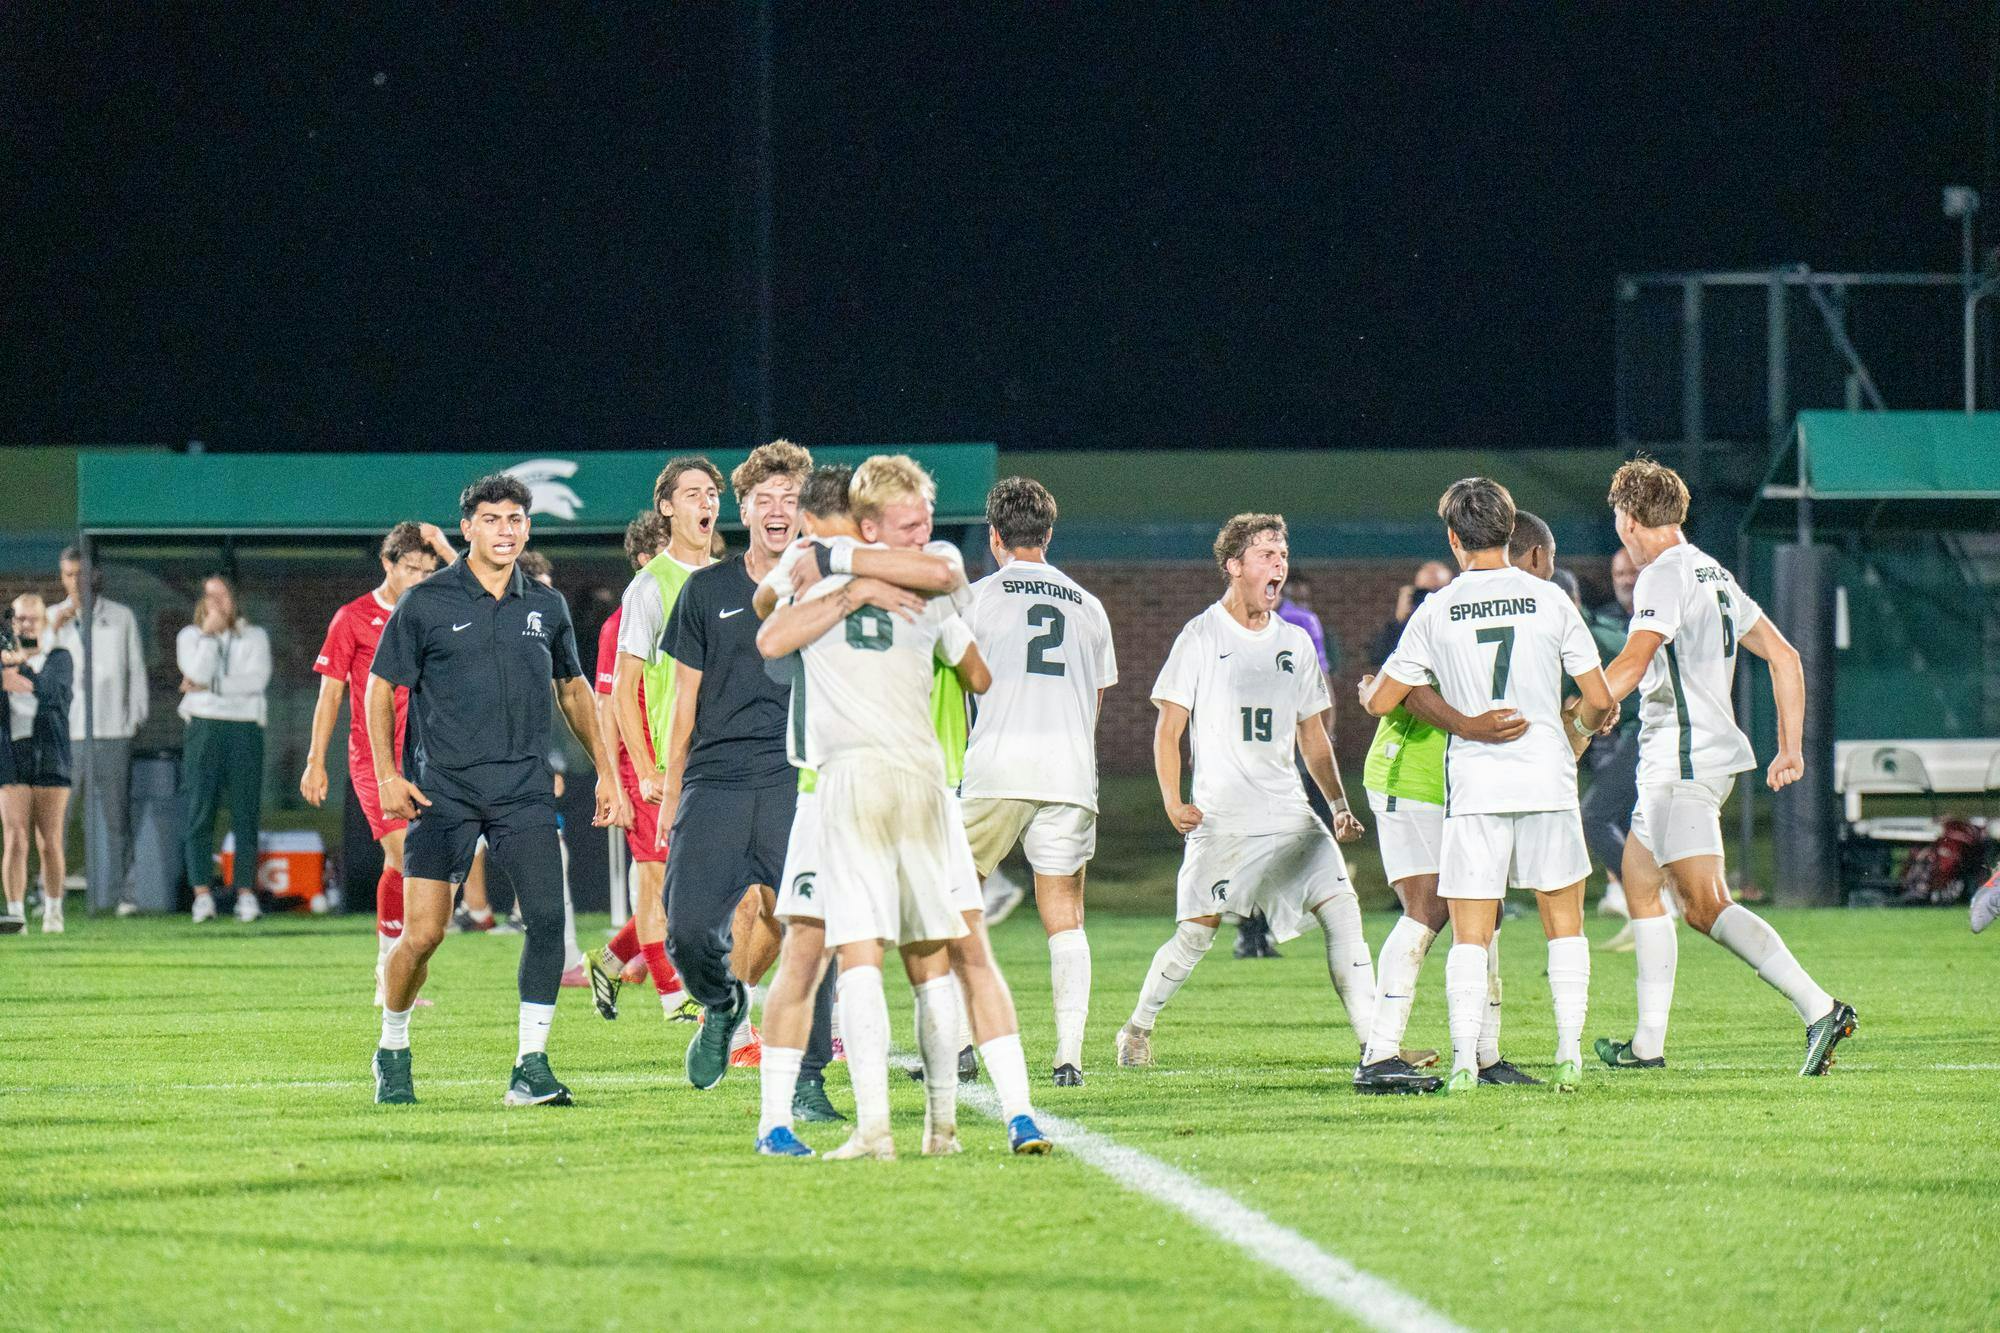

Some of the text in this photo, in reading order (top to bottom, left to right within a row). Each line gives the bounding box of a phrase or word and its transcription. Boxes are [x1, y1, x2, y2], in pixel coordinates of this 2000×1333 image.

[1002, 581, 1082, 605] SPARTANS
[1450, 598, 1536, 621] SPARTANS
[1027, 604, 1065, 677] 2
[1716, 590, 1735, 658] 6
[1476, 626, 1515, 700] 7
[1240, 706, 1272, 742] 19
[259, 858, 289, 893] G
